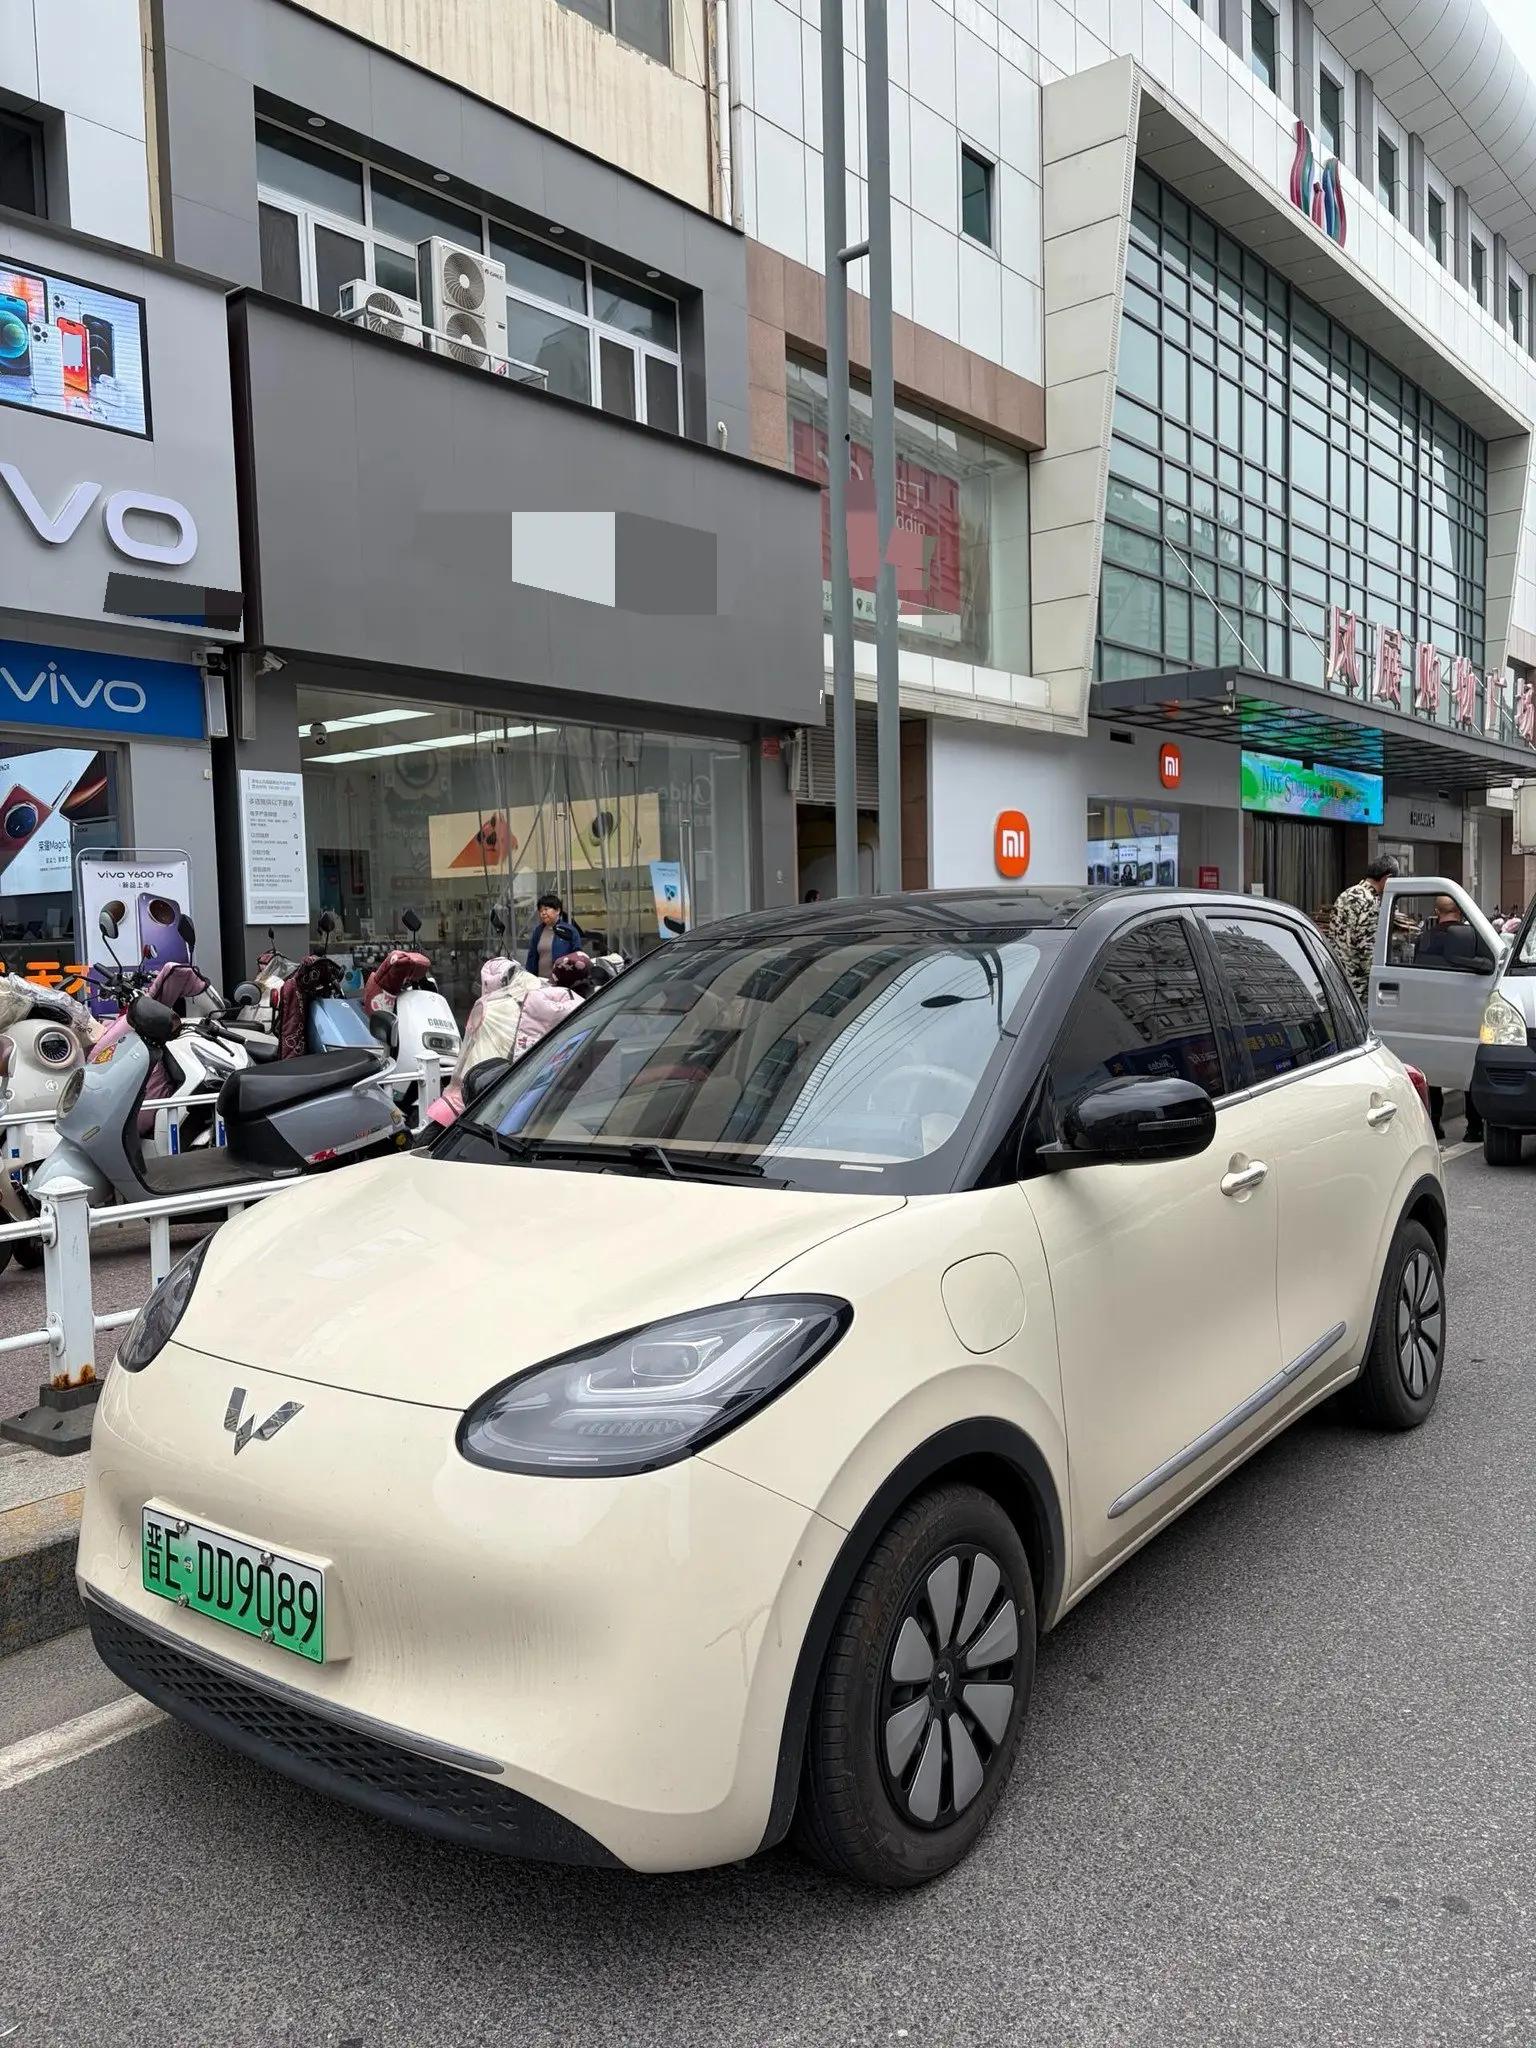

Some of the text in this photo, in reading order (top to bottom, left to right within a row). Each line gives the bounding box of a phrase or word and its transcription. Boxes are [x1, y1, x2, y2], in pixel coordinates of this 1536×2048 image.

[0, 661, 147, 714] vivo
[97, 870, 174, 879] vivo Y600 Pro
